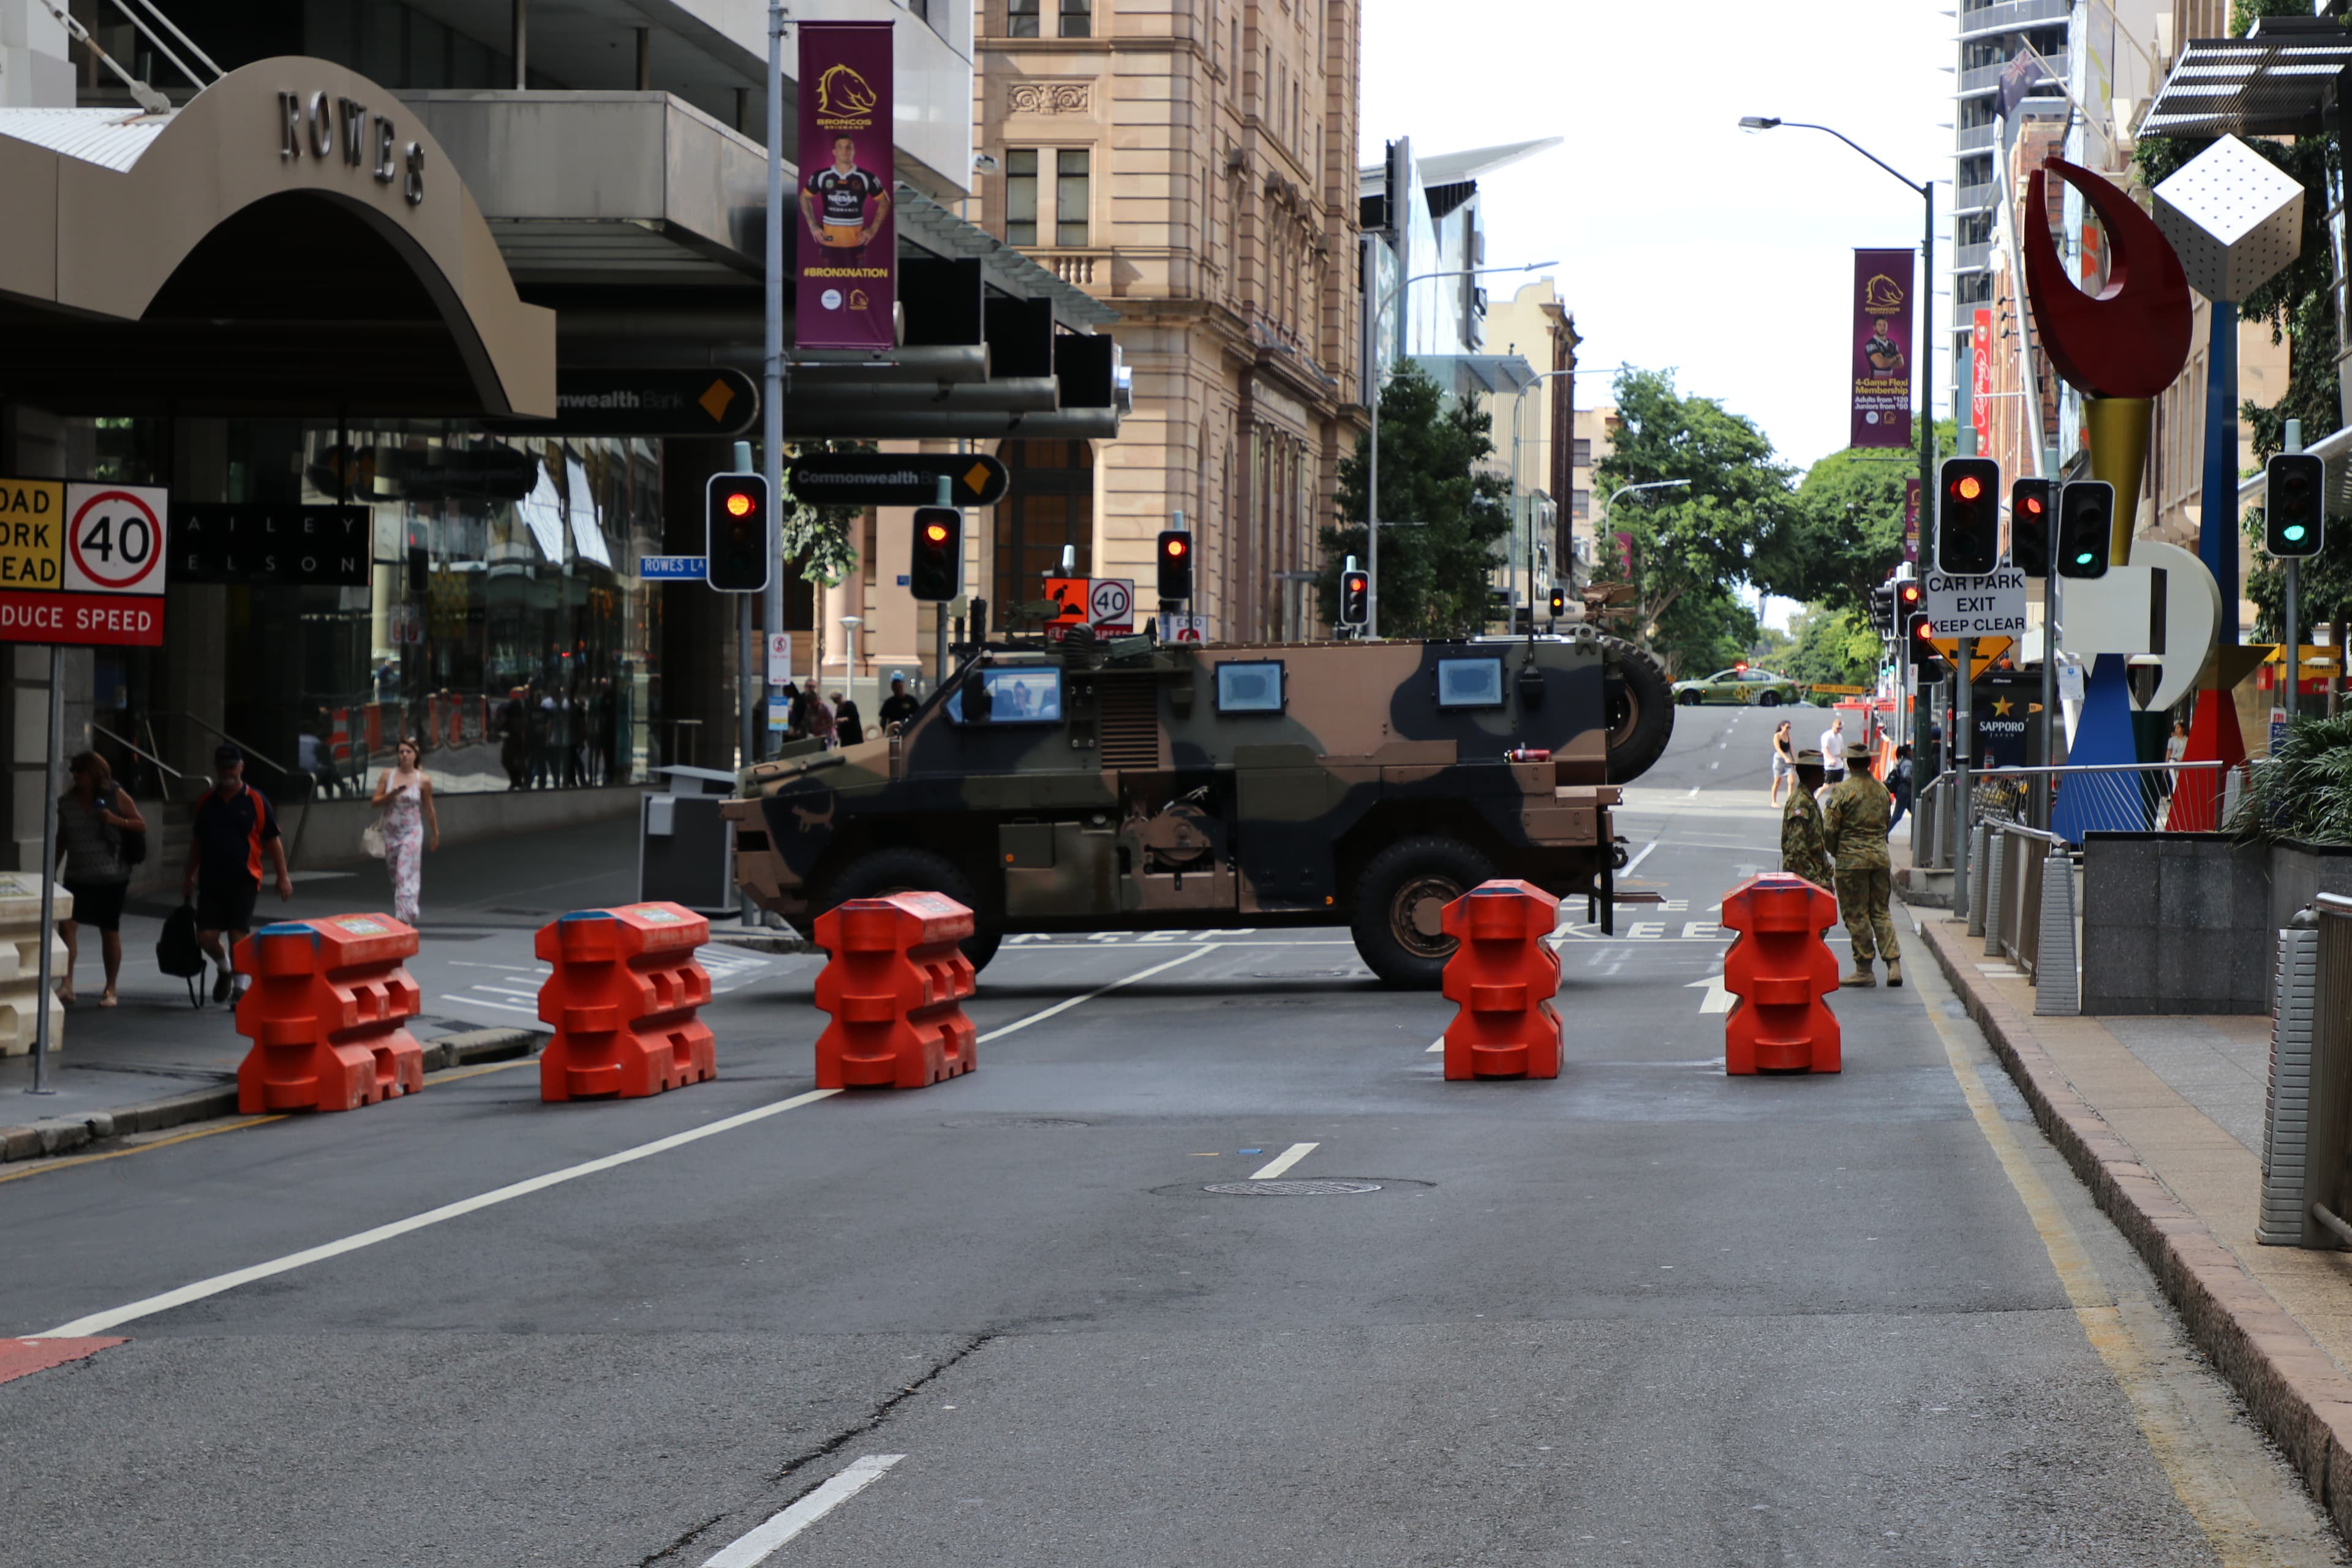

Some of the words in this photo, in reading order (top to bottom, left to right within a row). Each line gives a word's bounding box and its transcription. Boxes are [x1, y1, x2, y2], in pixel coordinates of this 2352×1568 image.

[279, 89, 425, 206] ROWES
[804, 267, 888, 278] #BRONXNATION
[1855, 378, 1887, 386] 4-Game
[1855, 386, 1908, 396] Membership
[556, 391, 639, 409] nwealth
[643, 392, 685, 409] Bank
[797, 470, 918, 484] Commonwealth
[0, 489, 49, 514] OAD
[187, 516, 355, 534] AILEY
[0, 523, 49, 548] ORK
[80, 516, 149, 565] 40
[2, 556, 56, 582] EAD
[188, 554, 356, 572] ELSON
[644, 559, 685, 572] ROWES
[1929, 576, 1967, 592] CAR
[1973, 573, 2024, 591] PARK
[1096, 592, 1125, 611] 40
[1957, 597, 1996, 612] EXIT
[1, 605, 64, 628] DUCE
[76, 608, 151, 631] SPEED
[1930, 619, 1969, 632] KEEP
[1974, 617, 2025, 631] CLEAR
[1979, 721, 2024, 732] SAPPORO
